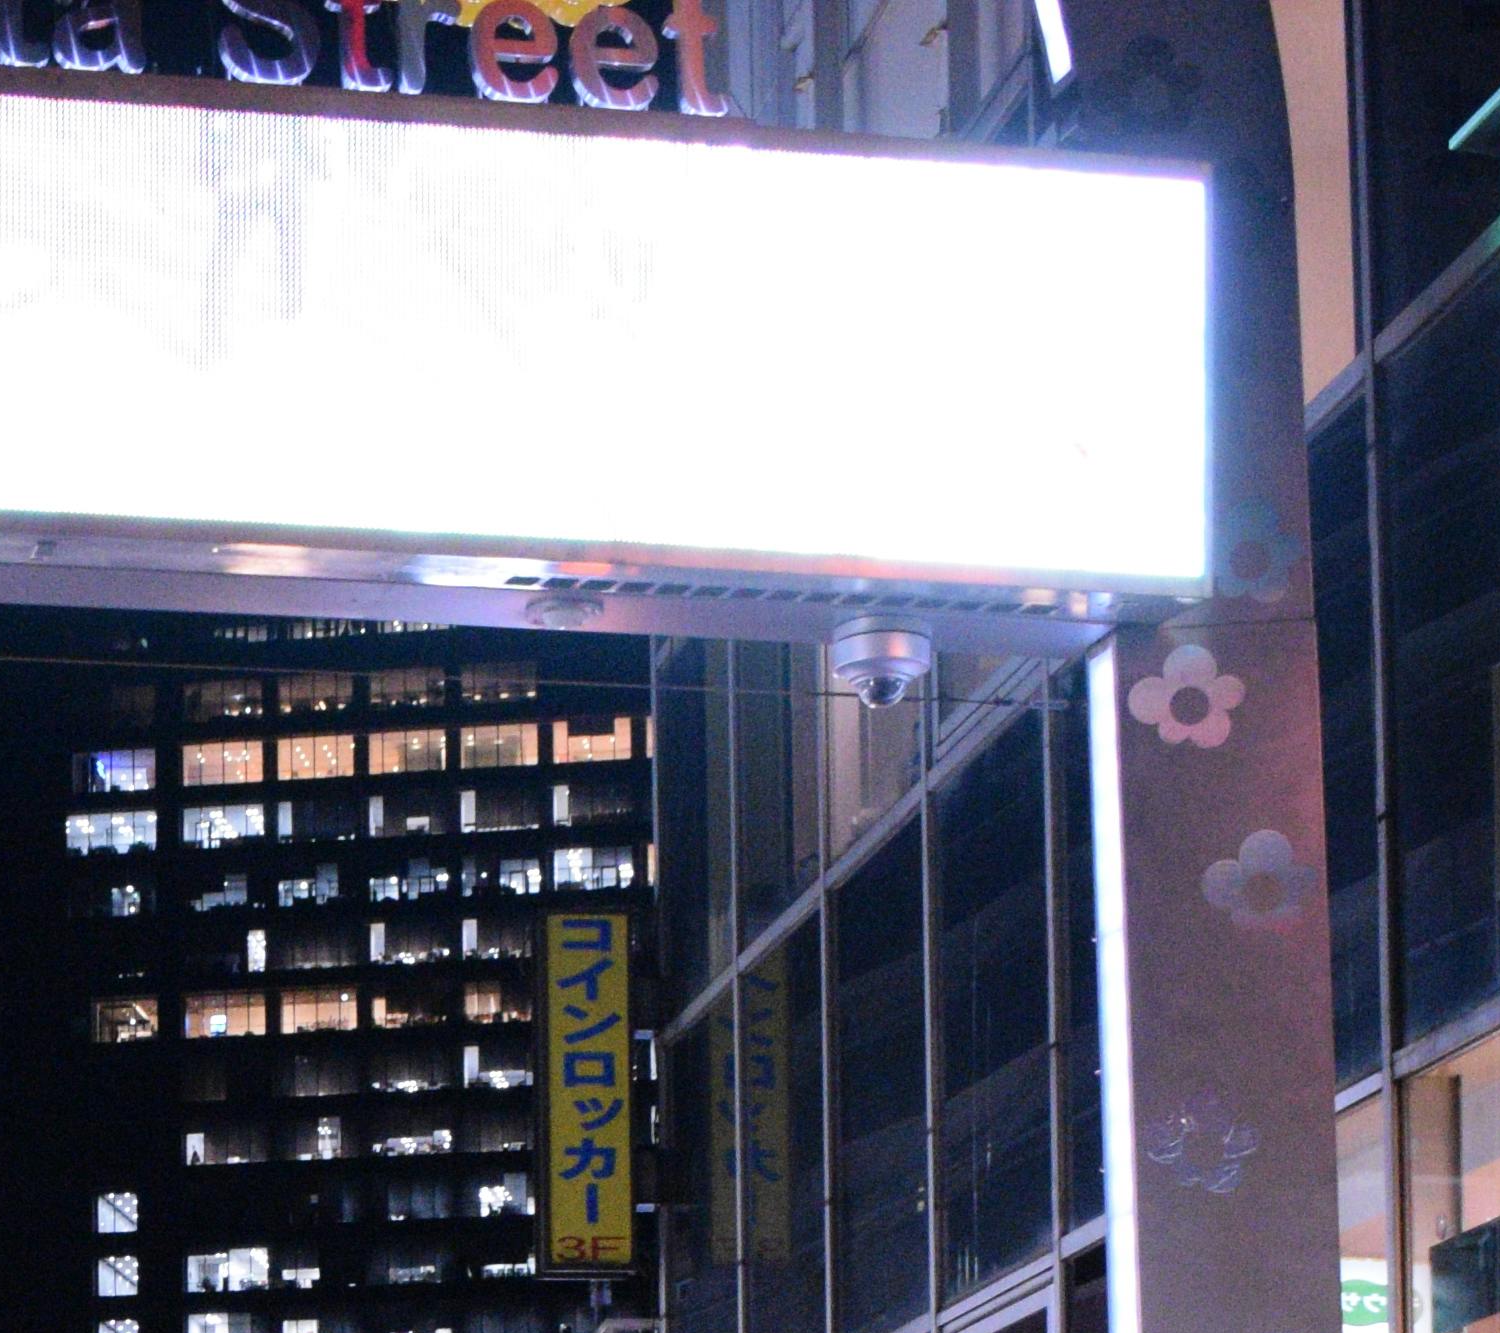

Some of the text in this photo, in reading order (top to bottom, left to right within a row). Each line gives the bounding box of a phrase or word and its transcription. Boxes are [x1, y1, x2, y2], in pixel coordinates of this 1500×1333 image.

[218, 0, 728, 117] Street
[558, 917, 622, 1226] コインロッカー
[556, 1236, 625, 1262] 3F
